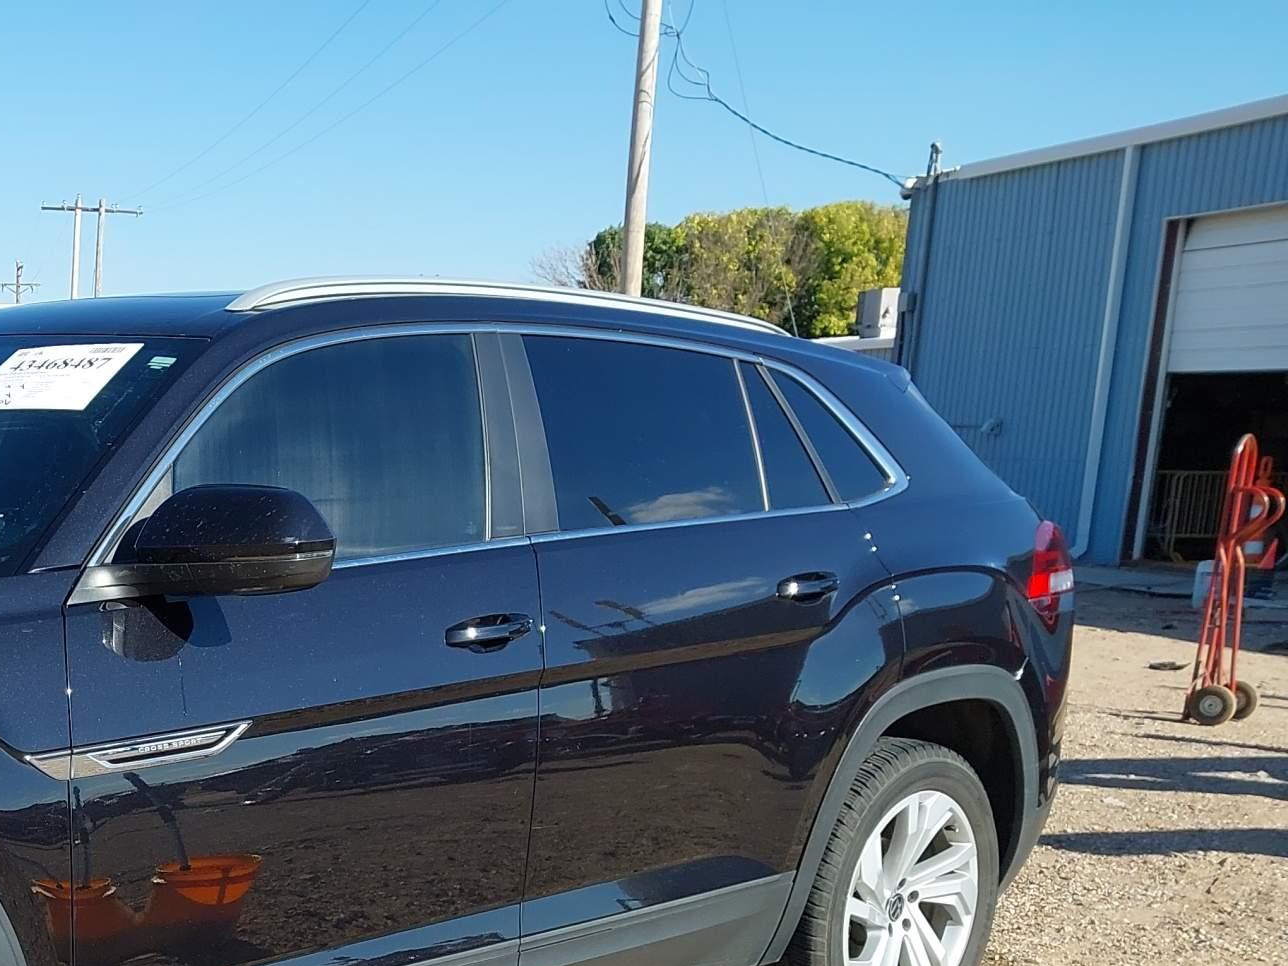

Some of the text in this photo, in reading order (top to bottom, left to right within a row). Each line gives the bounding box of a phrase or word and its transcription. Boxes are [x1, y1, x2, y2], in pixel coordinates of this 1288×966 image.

[9, 357, 113, 373] 43468487
[138, 738, 201, 753] CROSS SPORT
